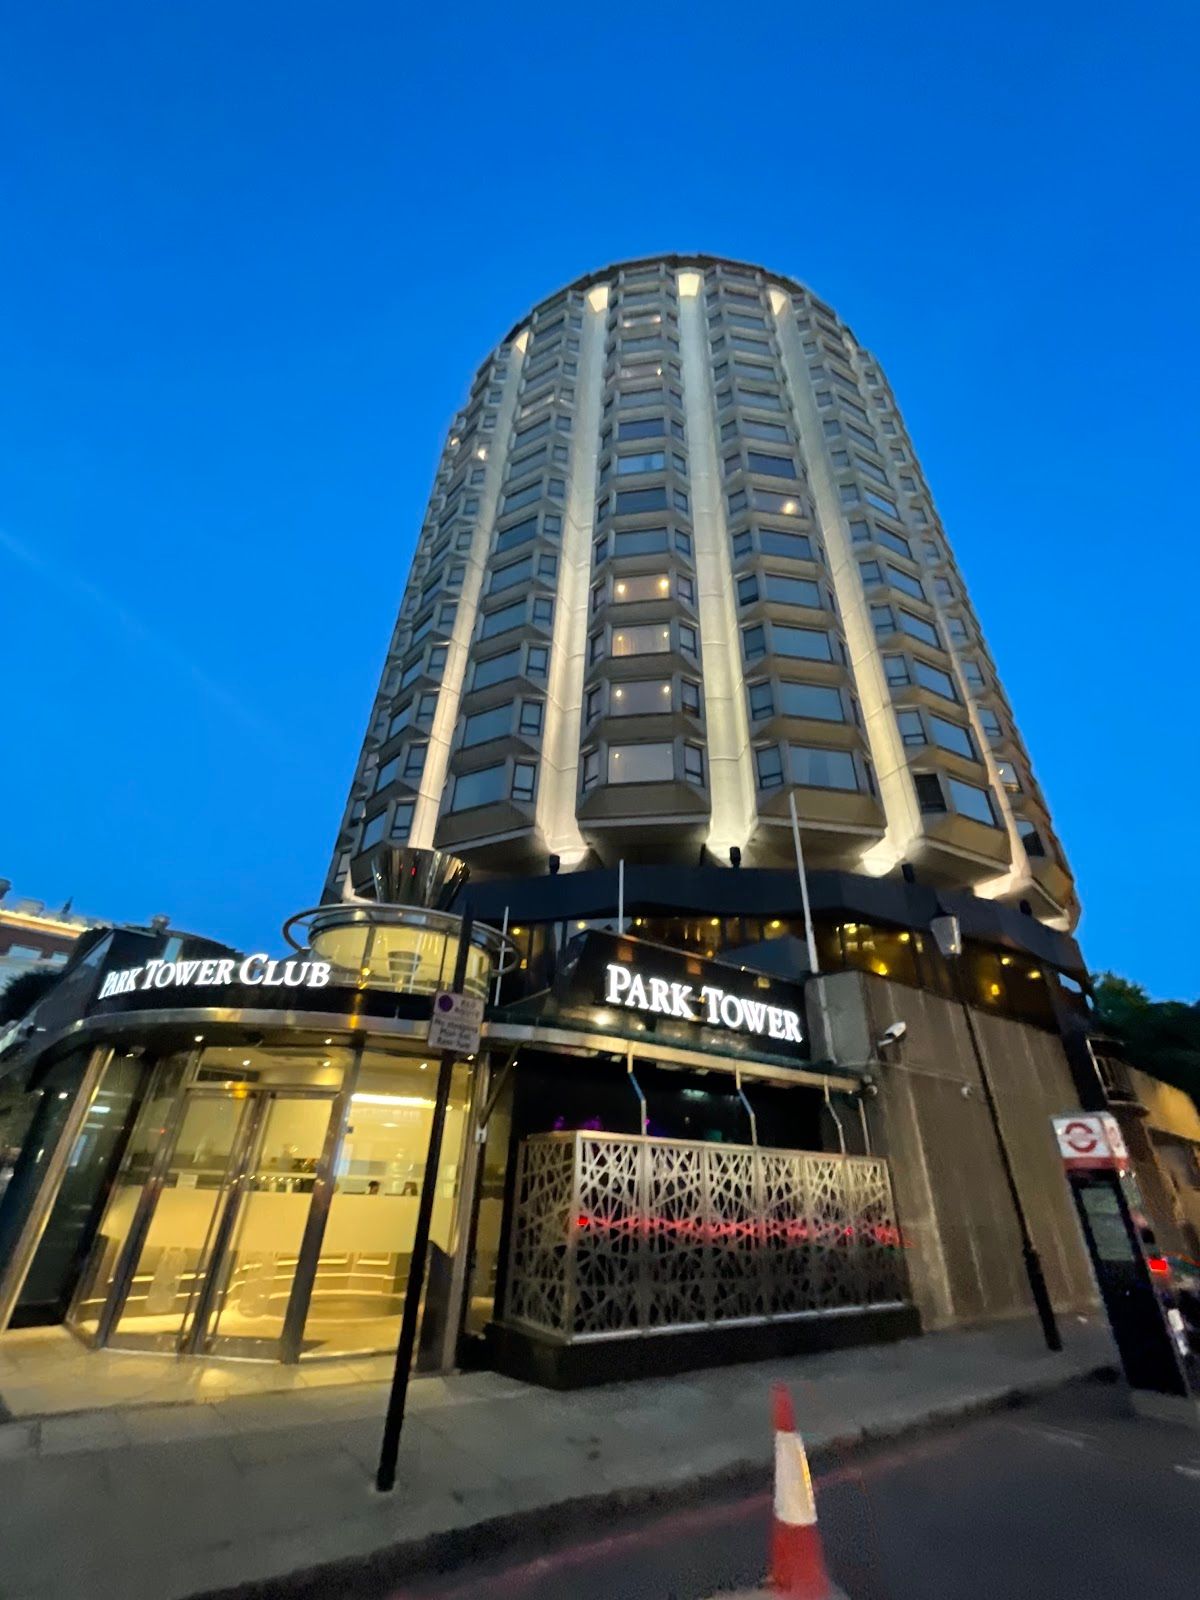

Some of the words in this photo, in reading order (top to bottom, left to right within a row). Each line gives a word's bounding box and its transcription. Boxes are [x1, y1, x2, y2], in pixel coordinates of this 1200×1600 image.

[97, 967, 144, 1000] PARK
[141, 959, 235, 990] TOWER
[239, 953, 331, 987] CLUB
[605, 963, 694, 1020] PARK
[701, 985, 803, 1043] TOWER
